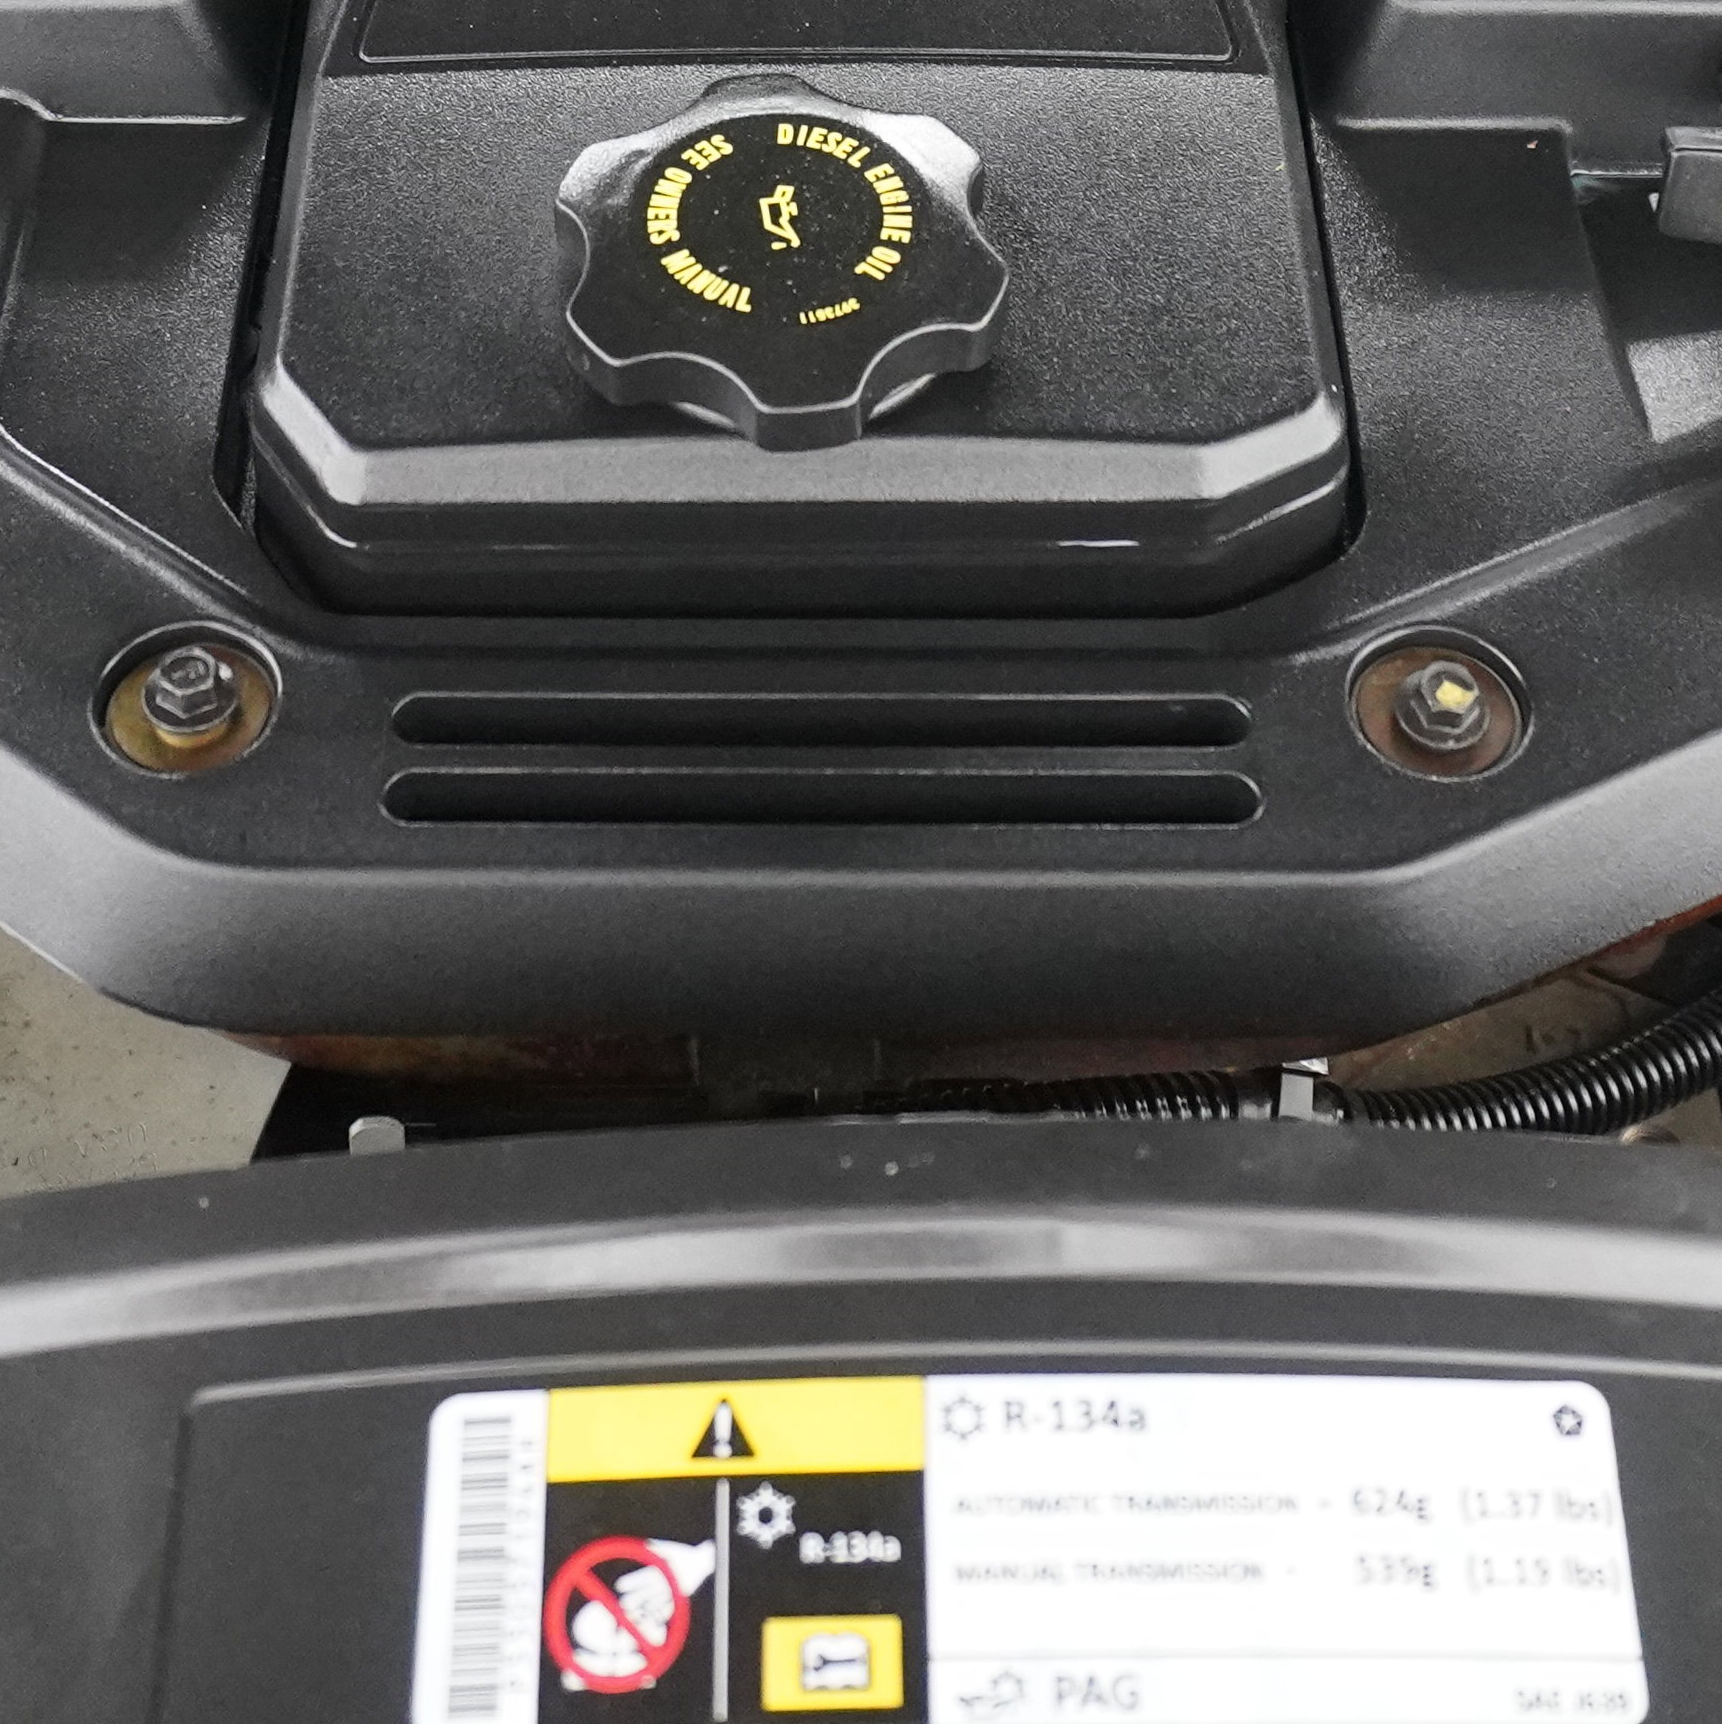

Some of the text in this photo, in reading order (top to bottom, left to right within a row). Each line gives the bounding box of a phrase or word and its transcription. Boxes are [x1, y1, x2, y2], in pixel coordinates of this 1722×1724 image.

[681, 134, 733, 170] SEE
[777, 123, 913, 281] DIESEL ENGINE OIL
[660, 248, 752, 313] MANUAL
[1004, 1400, 1146, 1430] R-134a
[1352, 1487, 1433, 1525] 624g
[1055, 1673, 1140, 1710] PAG
